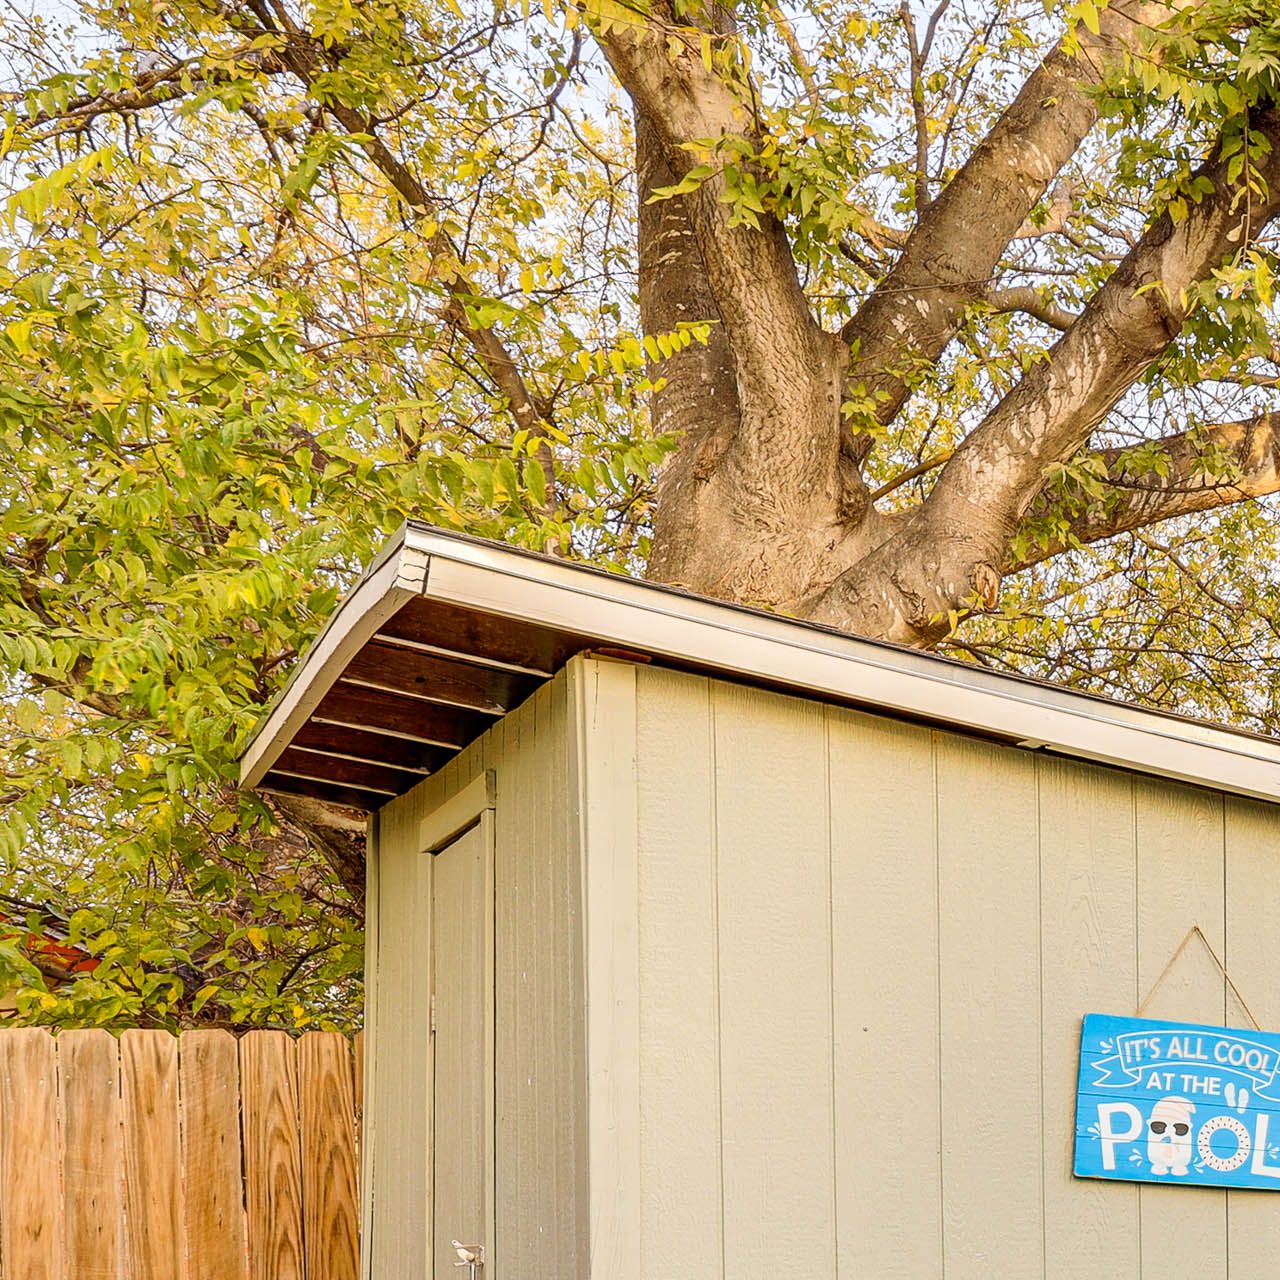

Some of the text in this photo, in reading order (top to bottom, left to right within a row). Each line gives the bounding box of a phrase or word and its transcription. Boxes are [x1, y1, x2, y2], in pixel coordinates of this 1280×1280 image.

[1125, 1037, 1272, 1077] IT'S ALL COOL
[1146, 1071, 1221, 1096] AT THE
